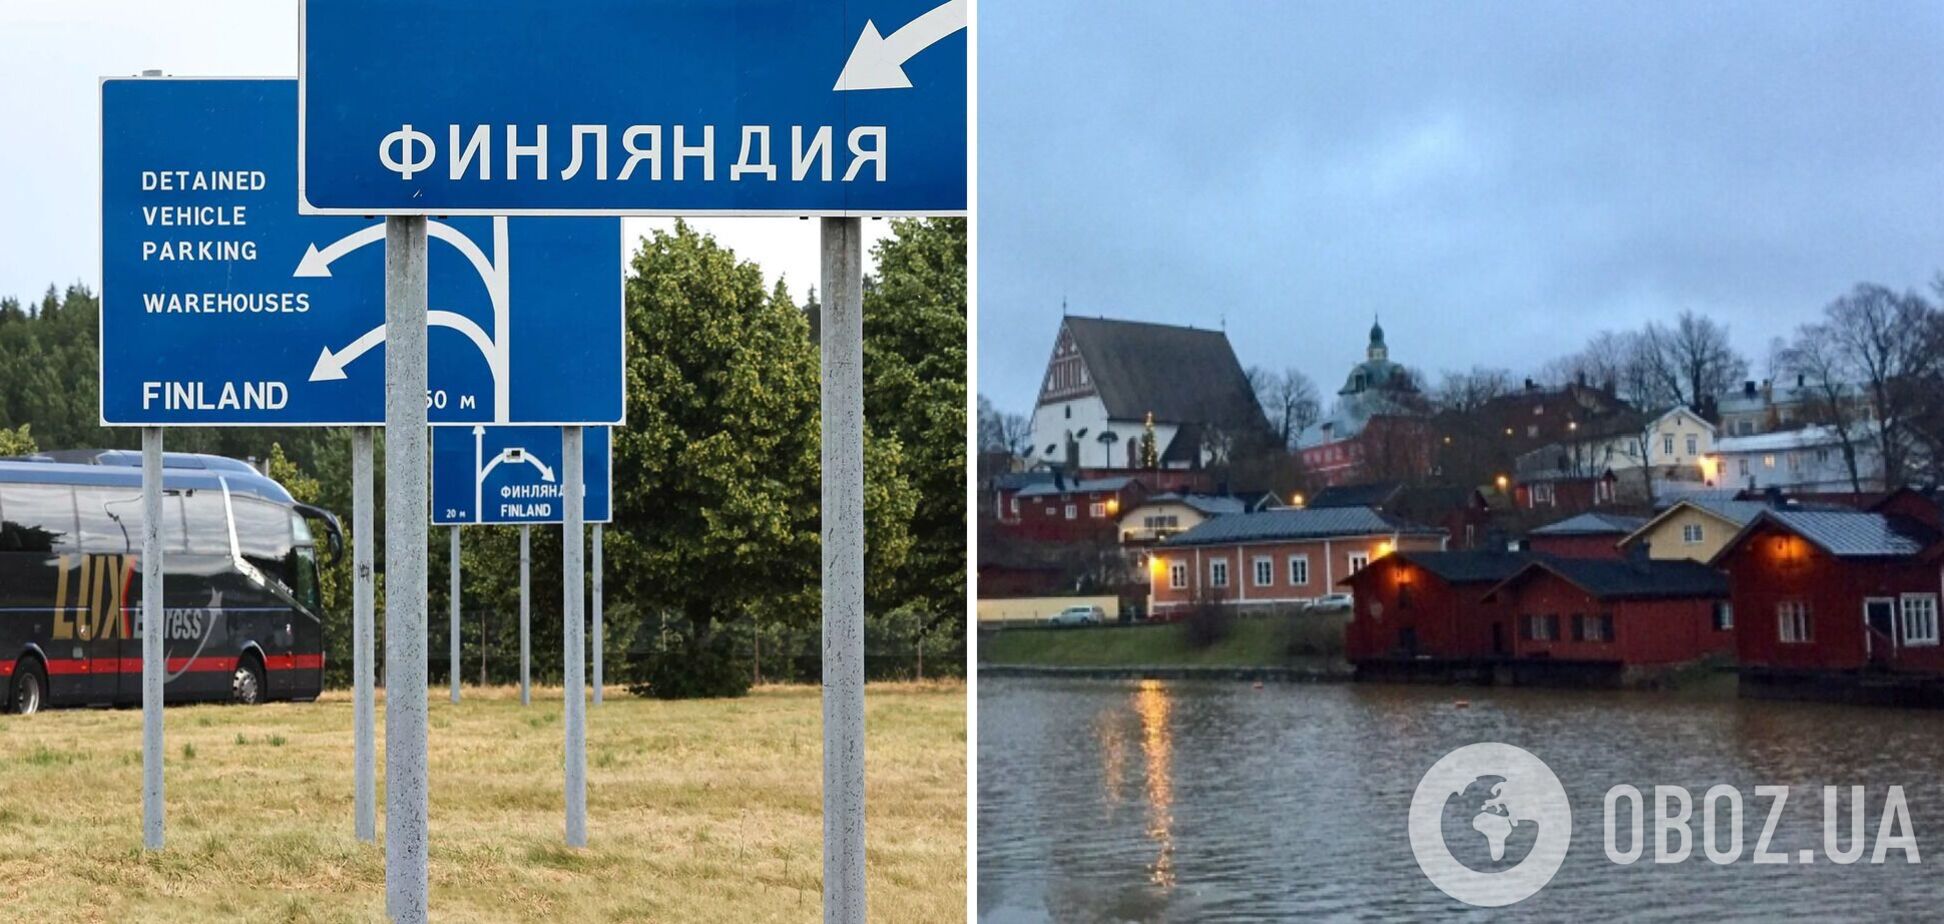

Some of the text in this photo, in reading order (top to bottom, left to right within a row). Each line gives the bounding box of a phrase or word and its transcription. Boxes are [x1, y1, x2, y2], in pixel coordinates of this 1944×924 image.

[379, 124, 888, 182] ФИНЛЯНДИЯ
[142, 171, 266, 191] DETAINED
[142, 206, 247, 226] VEHICLE
[142, 241, 257, 261] PARKING
[142, 293, 310, 313] WAREHOUSES
[142, 381, 288, 410] FINLAND
[500, 484, 586, 499] ФИНЛЯН
[446, 508, 457, 518] 20
[500, 503, 551, 517] FINLAND
[53, 553, 137, 641] LUX
[133, 600, 202, 640] Eress
